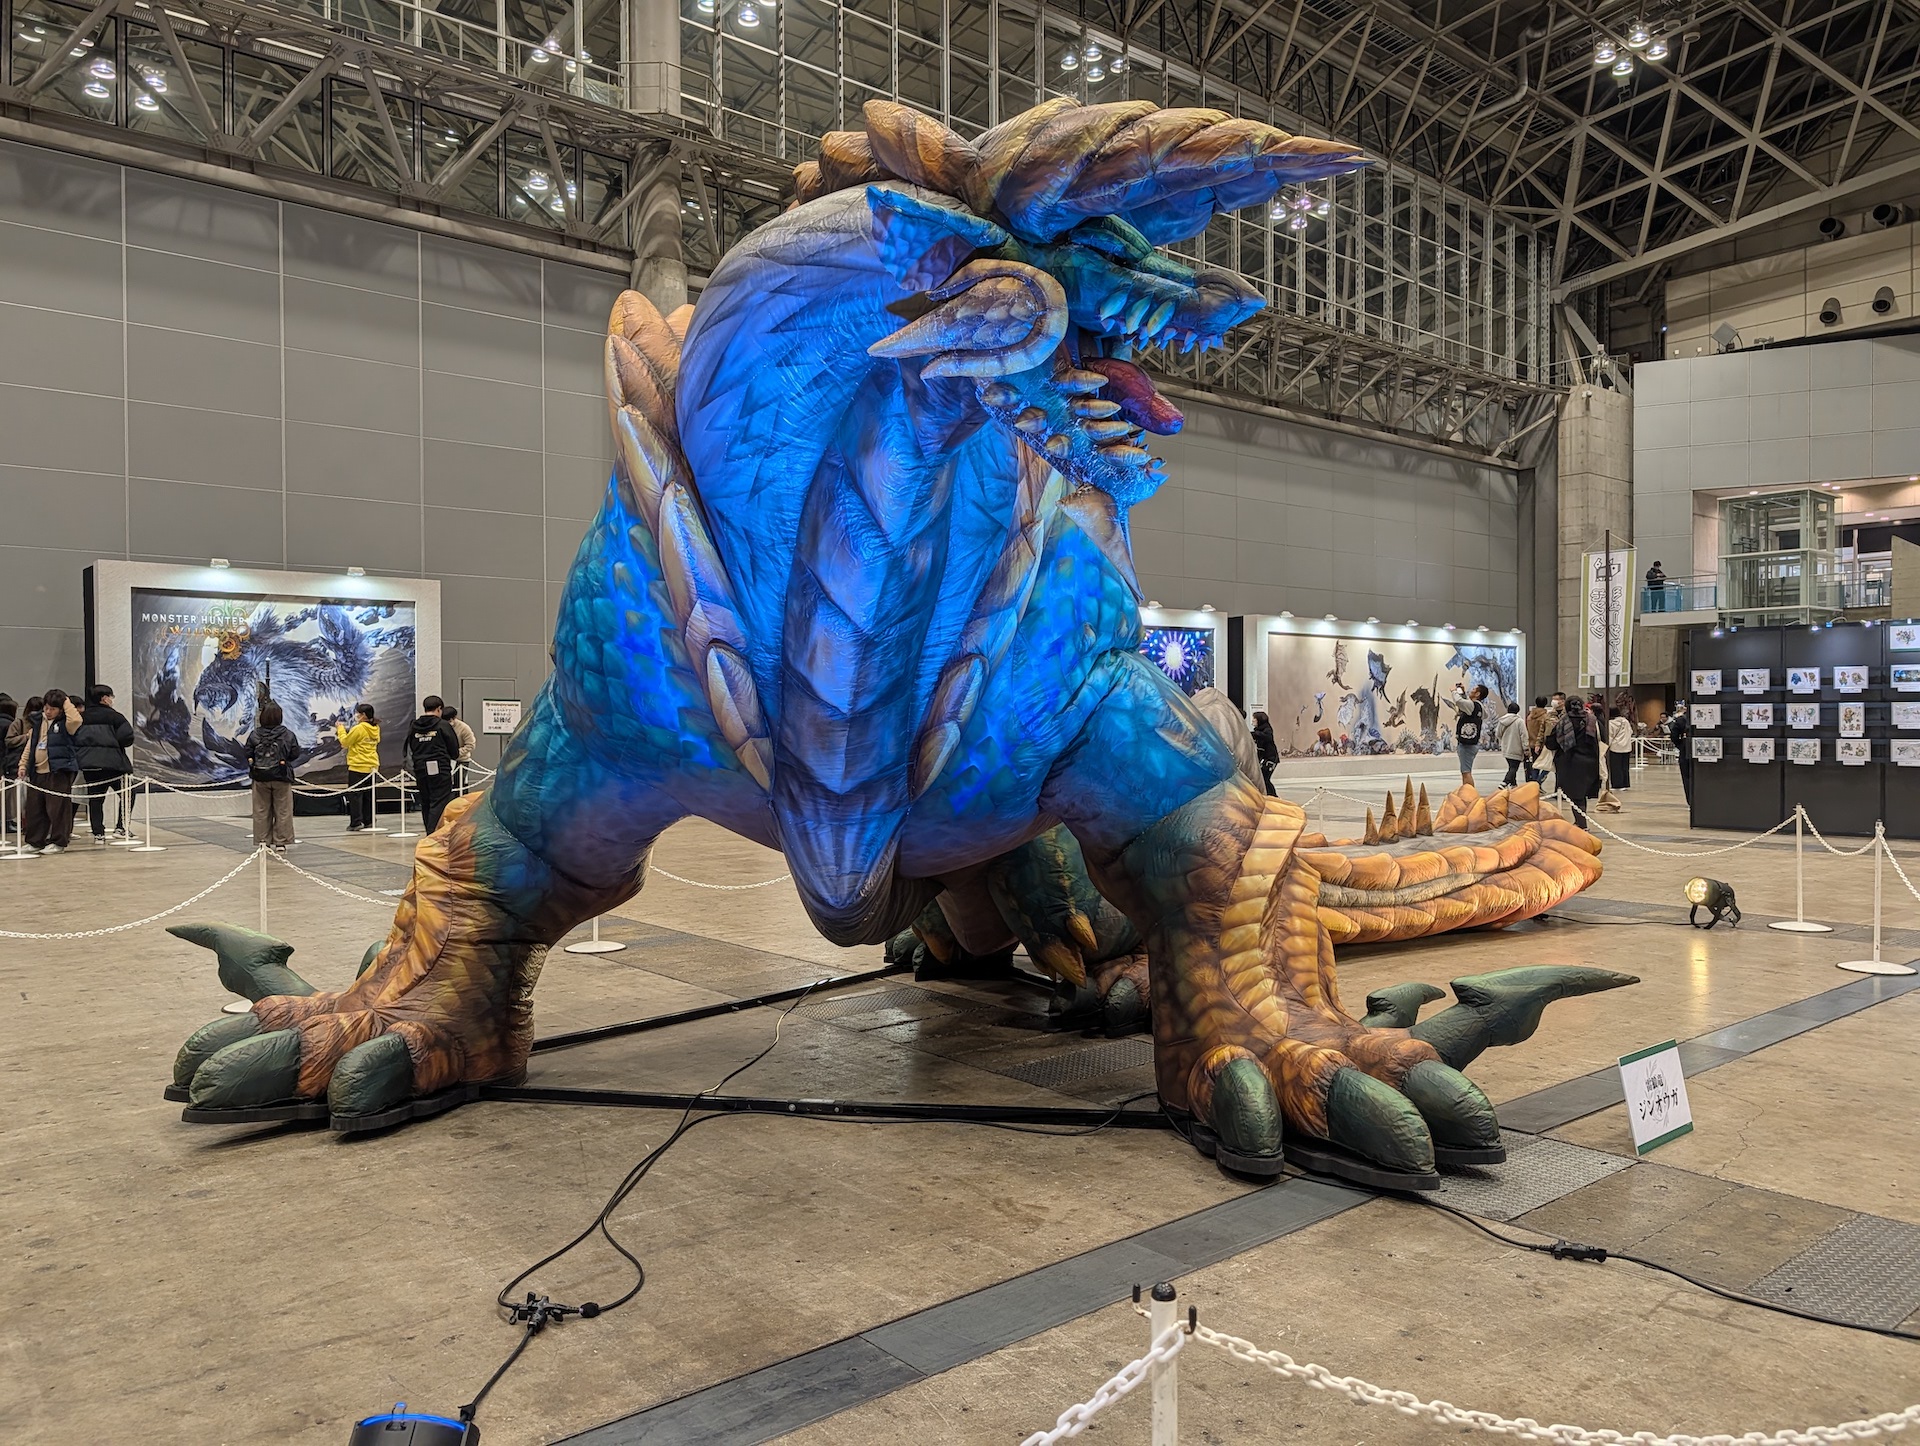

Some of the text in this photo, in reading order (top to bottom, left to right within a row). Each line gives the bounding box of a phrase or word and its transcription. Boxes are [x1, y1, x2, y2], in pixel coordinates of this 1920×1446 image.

[141, 613, 246, 626] MONSTER HUNTER
[1639, 1087, 1678, 1121] ジンオウガ
